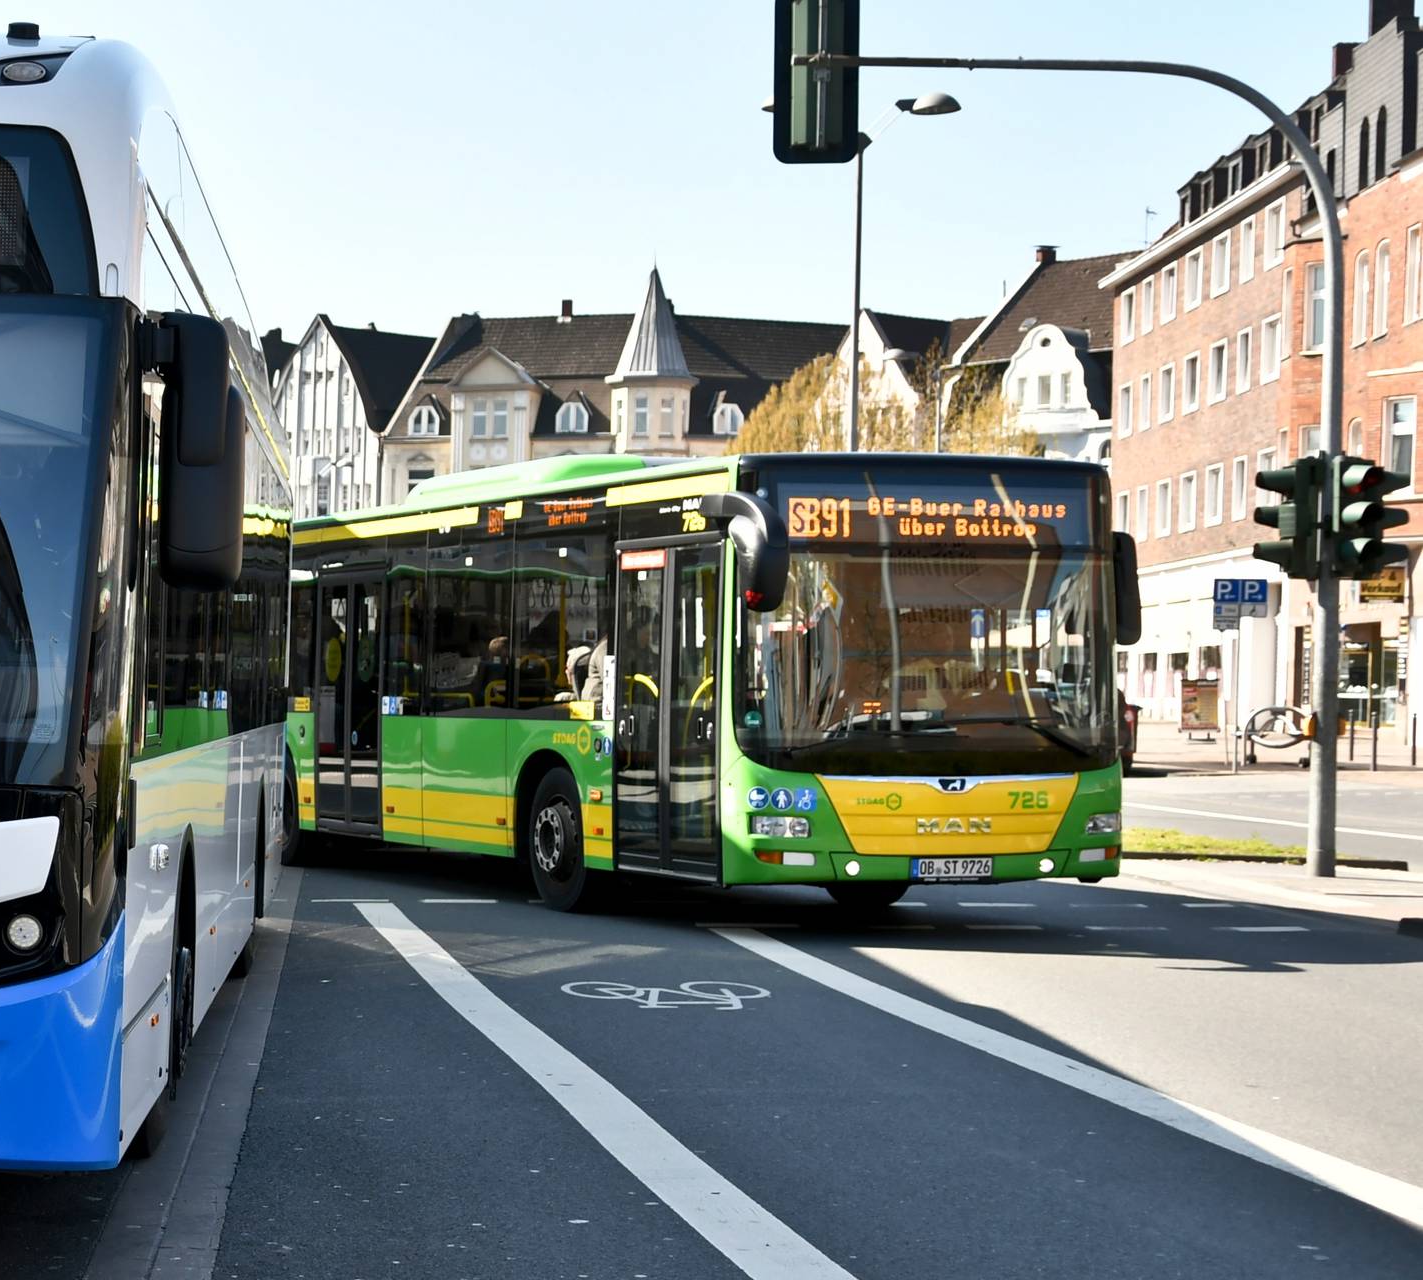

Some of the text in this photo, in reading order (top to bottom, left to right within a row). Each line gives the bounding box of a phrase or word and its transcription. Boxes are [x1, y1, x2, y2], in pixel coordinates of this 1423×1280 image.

[789, 498, 851, 537] SB91
[1216, 580, 1233, 600] P
[1244, 580, 1261, 600] P
[1361, 582, 1403, 594] Verkauf
[1008, 791, 1049, 809] 726
[917, 817, 992, 833] MAN
[919, 859, 990, 875] OB ST 9726
